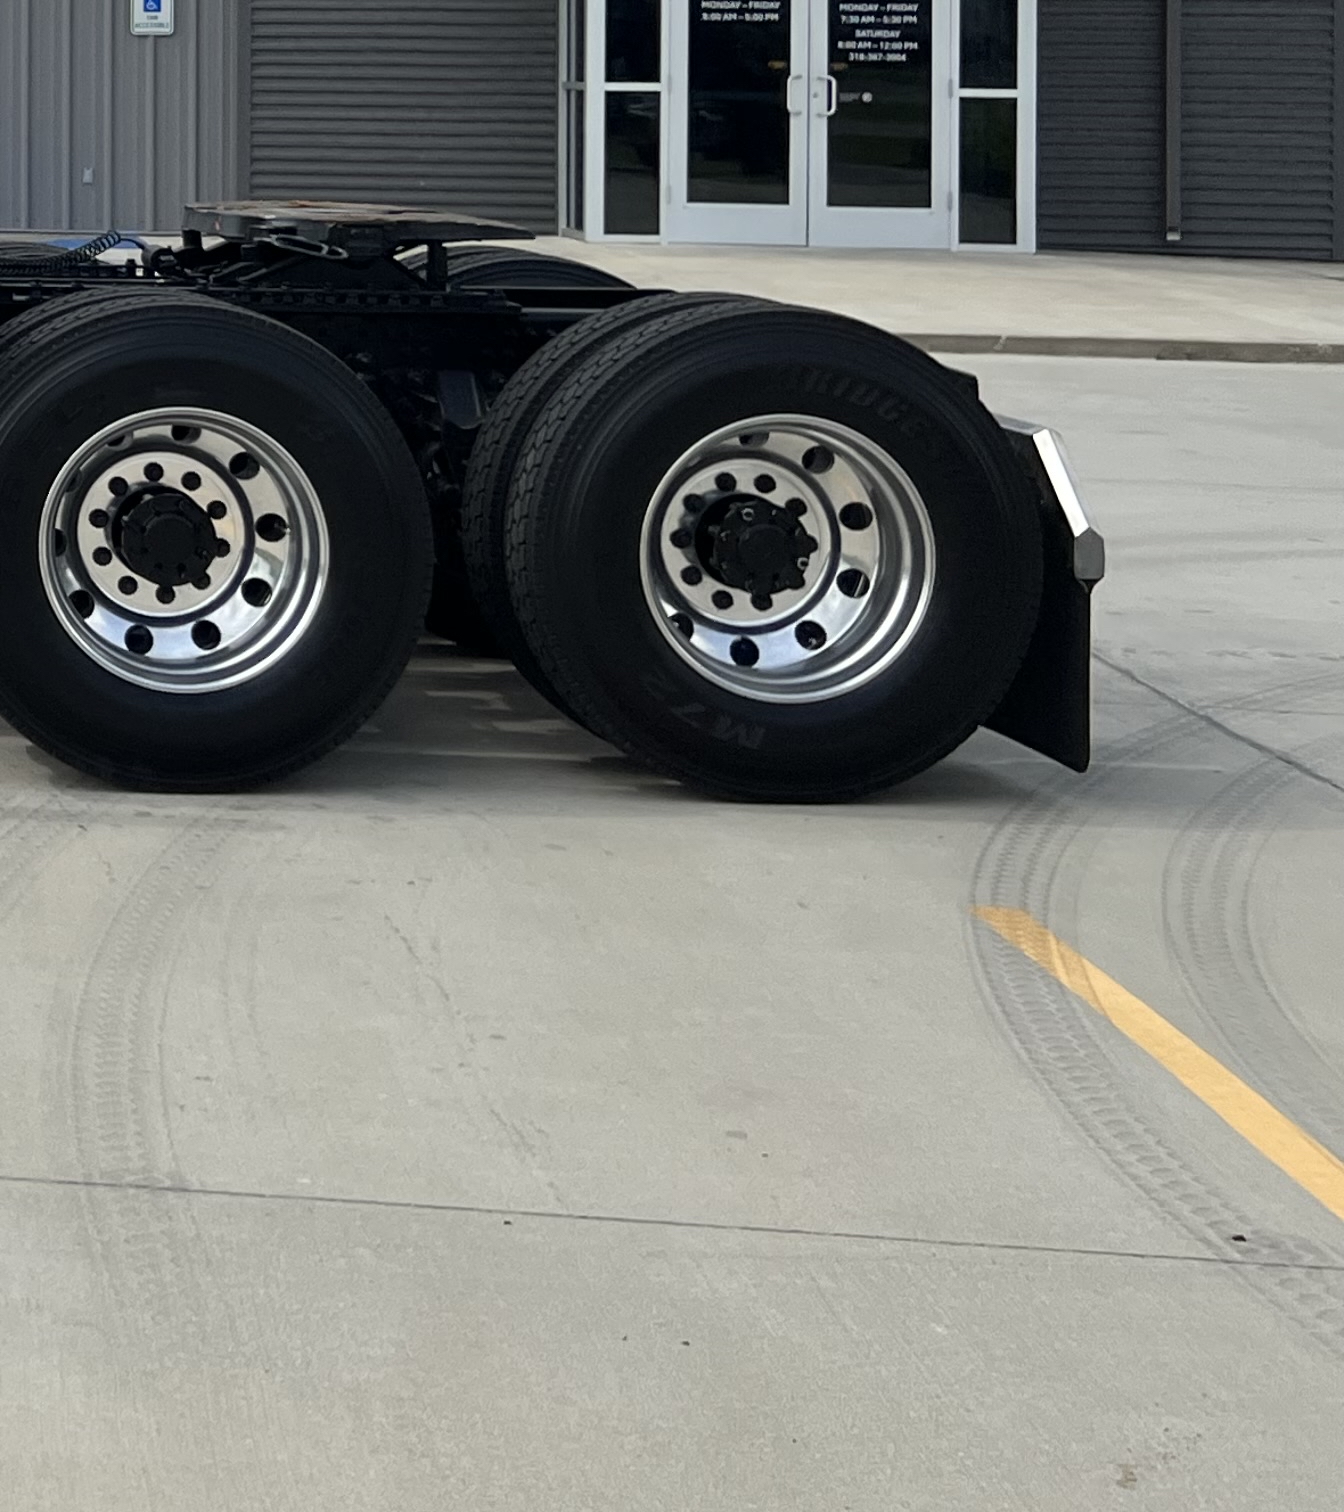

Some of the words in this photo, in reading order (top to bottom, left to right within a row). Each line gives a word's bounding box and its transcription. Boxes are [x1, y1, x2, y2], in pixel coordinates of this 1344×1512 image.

[701, 0, 741, 9] MONDAY
[748, 0, 781, 9] FRIDAY
[839, 3, 879, 12] MONDAY
[886, 3, 918, 12] FRIDAY
[855, 29, 901, 38] SATURDAY
